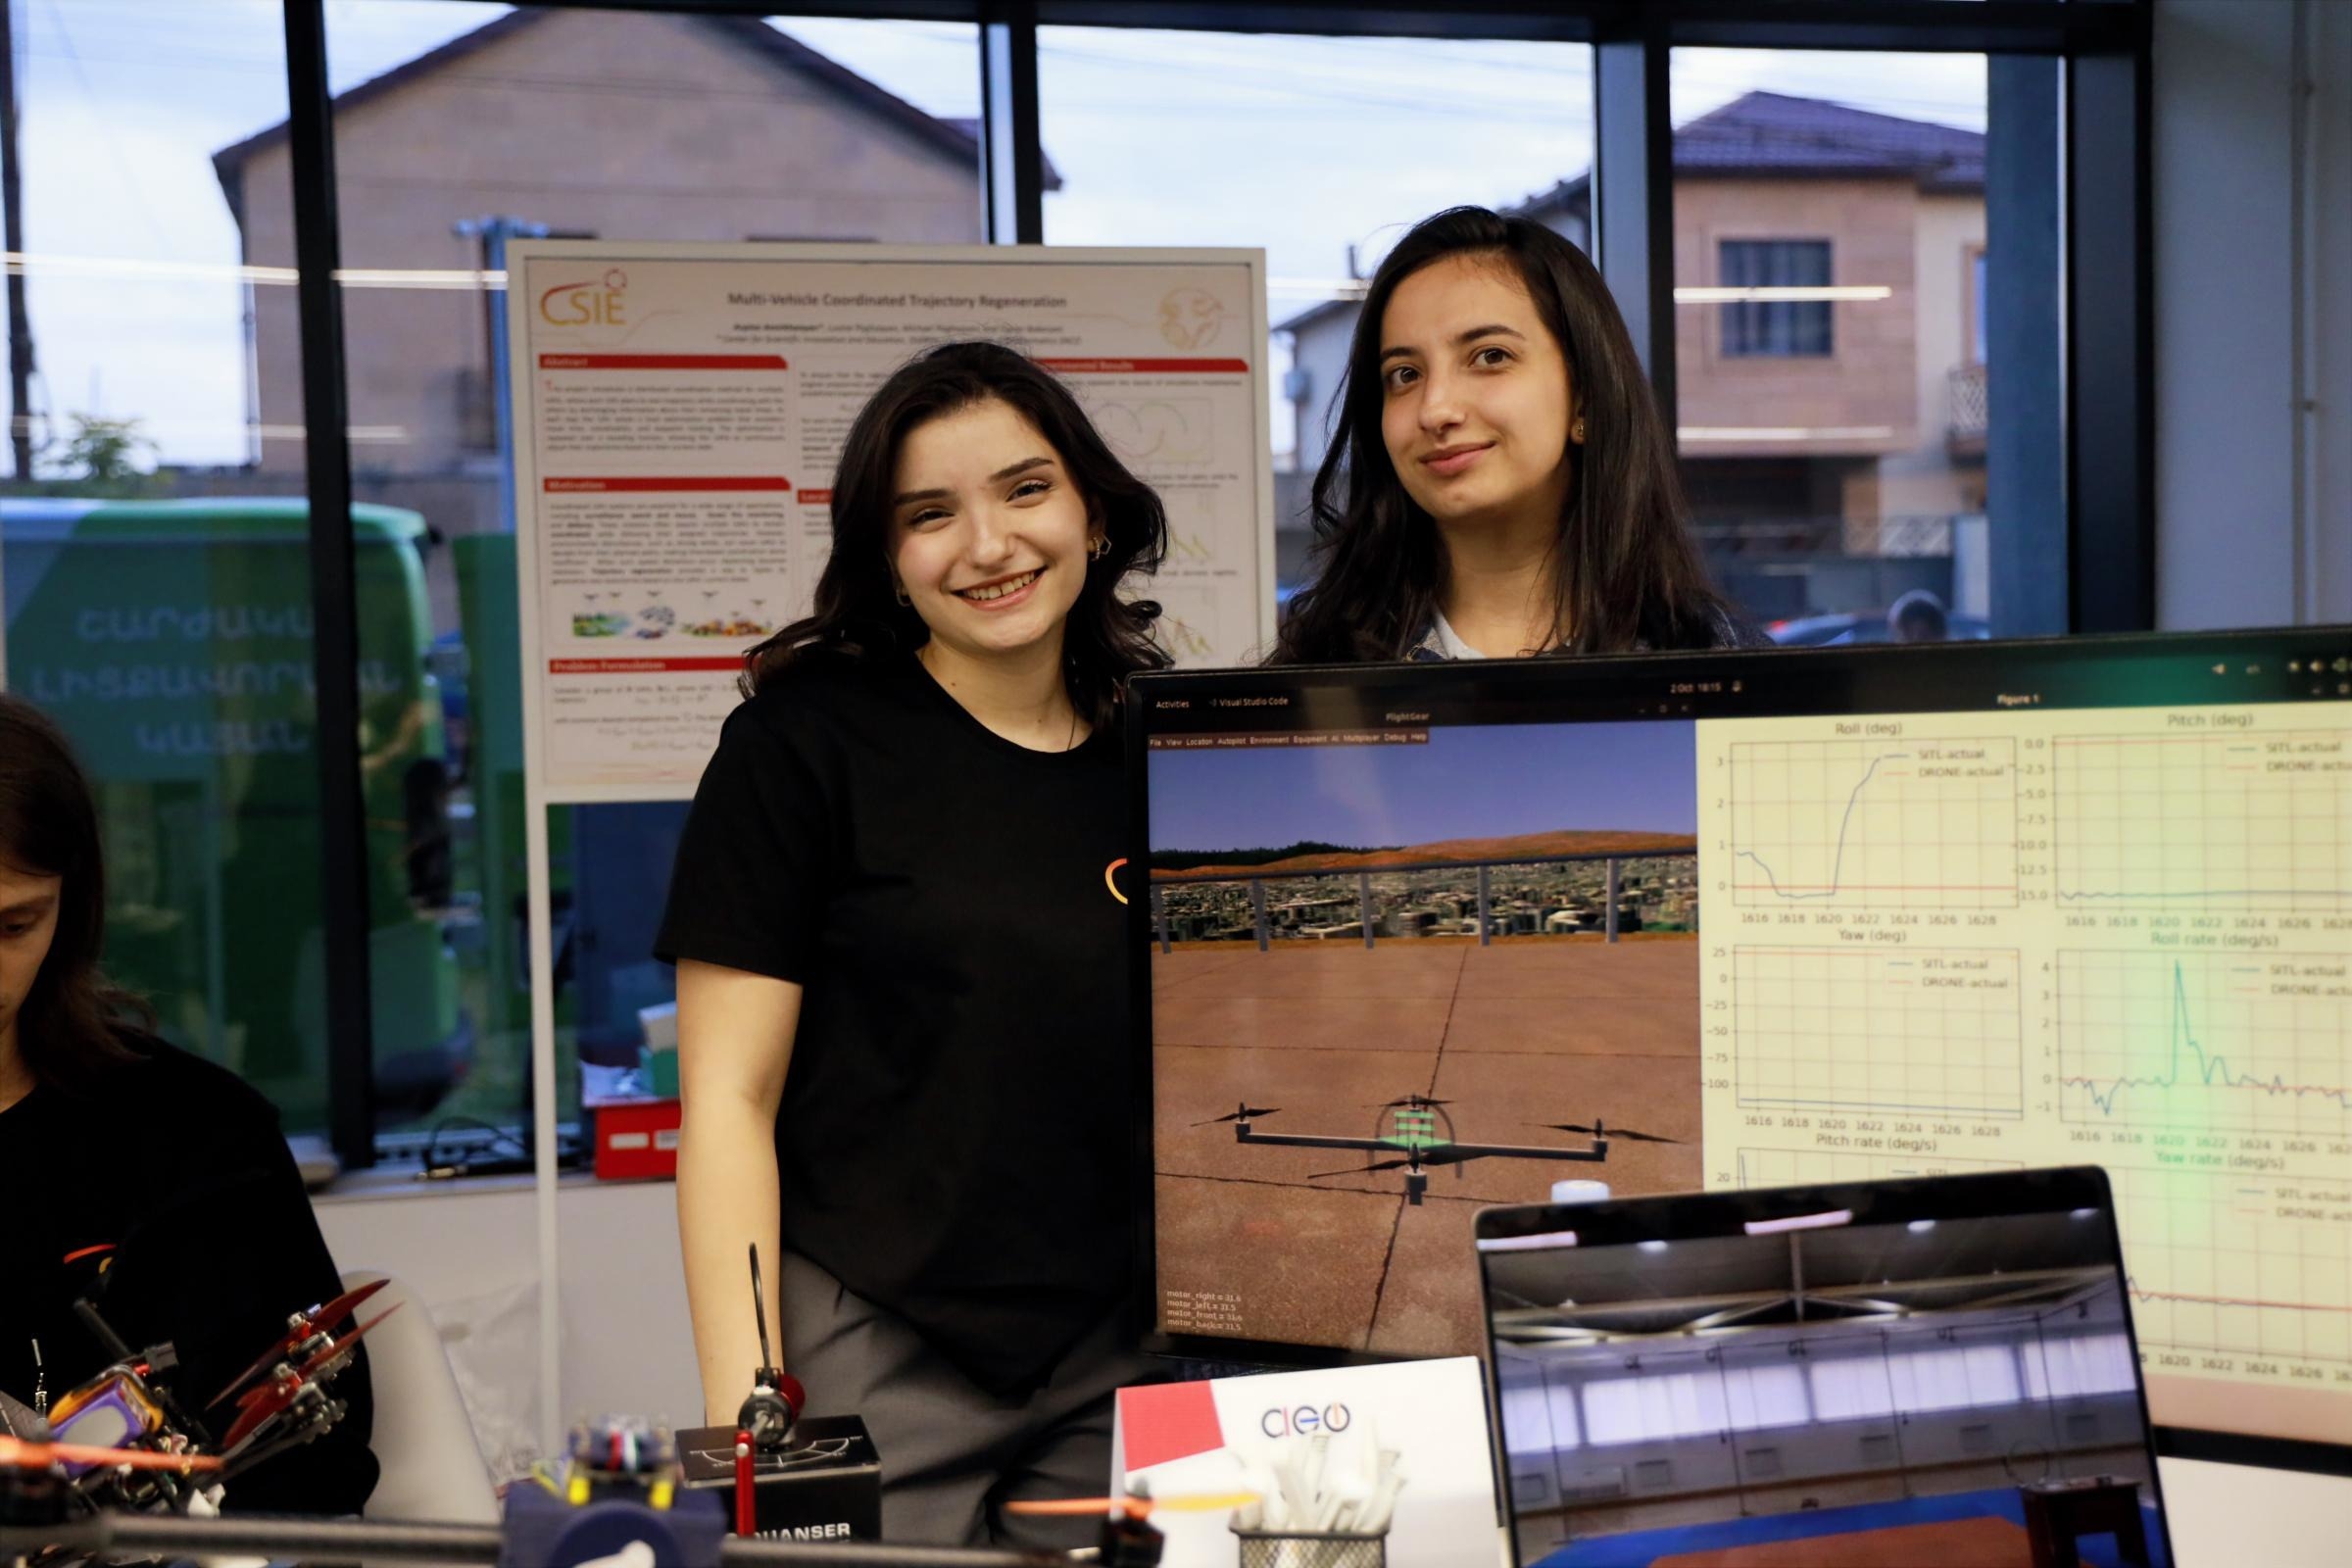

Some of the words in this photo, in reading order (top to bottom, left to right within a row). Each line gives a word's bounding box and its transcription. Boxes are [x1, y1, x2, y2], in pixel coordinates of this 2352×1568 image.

[540, 280, 628, 325] CSIE
[726, 292, 818, 307] Multi-Vehicle
[821, 293, 906, 307] Coordinated
[909, 294, 975, 310] Trajectory
[978, 295, 1067, 310] Regeneration
[548, 480, 607, 490] Motivation
[74, 604, 314, 643] ՇԱՐԺԱԿԱ
[1219, 698, 1242, 707] Visual
[1243, 697, 1267, 707] Studio
[1268, 697, 1289, 706] Code
[1996, 693, 2032, 706] Figure
[1386, 712, 1430, 723] FlightGear
[2167, 713, 2205, 726] Pitch
[2211, 712, 2254, 728] (deg)
[1835, 722, 1861, 735] Roll
[1865, 721, 1902, 736] (deg)
[1217, 737, 1247, 747] Autopilot
[1250, 736, 1290, 745] Environment
[1293, 735, 1327, 745] Equipment
[1384, 732, 1406, 743] Debug
[2024, 739, 2044, 750] 0.0
[1741, 913, 1769, 923] 1616
[1778, 913, 1805, 923] 1618
[1814, 913, 1842, 923] 1620
[1851, 913, 1880, 924] 1622
[1889, 914, 1919, 925] 1624
[1929, 914, 1958, 925] 1626
[1967, 915, 1996, 926] 1628
[2065, 916, 2096, 927] 1616
[2107, 916, 2138, 927] 1618
[2148, 916, 2180, 927] 1620
[2190, 916, 2222, 928] 1622
[2234, 917, 2266, 928] 1624
[2278, 917, 2311, 929] 1626
[2323, 917, 2352, 929] 1628
[1838, 930, 1864, 941] Yaw
[1869, 929, 1908, 943] (deg)
[2150, 933, 2180, 946] Roll
[2184, 934, 2217, 946] rate
[2223, 933, 2279, 949] (deg/s)
[1712, 948, 1726, 957] 25
[1744, 1115, 1772, 1127] 1616
[1781, 1116, 1809, 1128] 1618
[1818, 1118, 1846, 1130] 1620
[1855, 1119, 1884, 1132] 1622
[1893, 1121, 1923, 1134] 1624
[1933, 1123, 1962, 1136] 1626
[1971, 1125, 2001, 1138] 1628
[1816, 1133, 1849, 1147] Pitch
[1854, 1135, 1883, 1149] rate
[1887, 1135, 1937, 1152] (deg/s)
[2070, 1130, 2101, 1142] 1616
[2111, 1132, 2143, 1144] 1618
[2153, 1134, 2185, 1146] 1620
[2195, 1136, 2228, 1149] 1622
[2239, 1138, 2272, 1151] 1624
[2282, 1141, 2317, 1153] 1626
[2328, 1143, 2352, 1154] 162
[2155, 1151, 2184, 1164] Yaw
[2188, 1152, 2223, 1165] rate
[2227, 1153, 2285, 1170] (deg/s)
[1717, 1172, 1731, 1183] 20
[2159, 1353, 2190, 1366] 1620
[2201, 1357, 2233, 1371] 1622
[2244, 1361, 2278, 1375] 1624
[2288, 1365, 2324, 1379] 1626
[754, 1522, 852, 1542] ANSER
